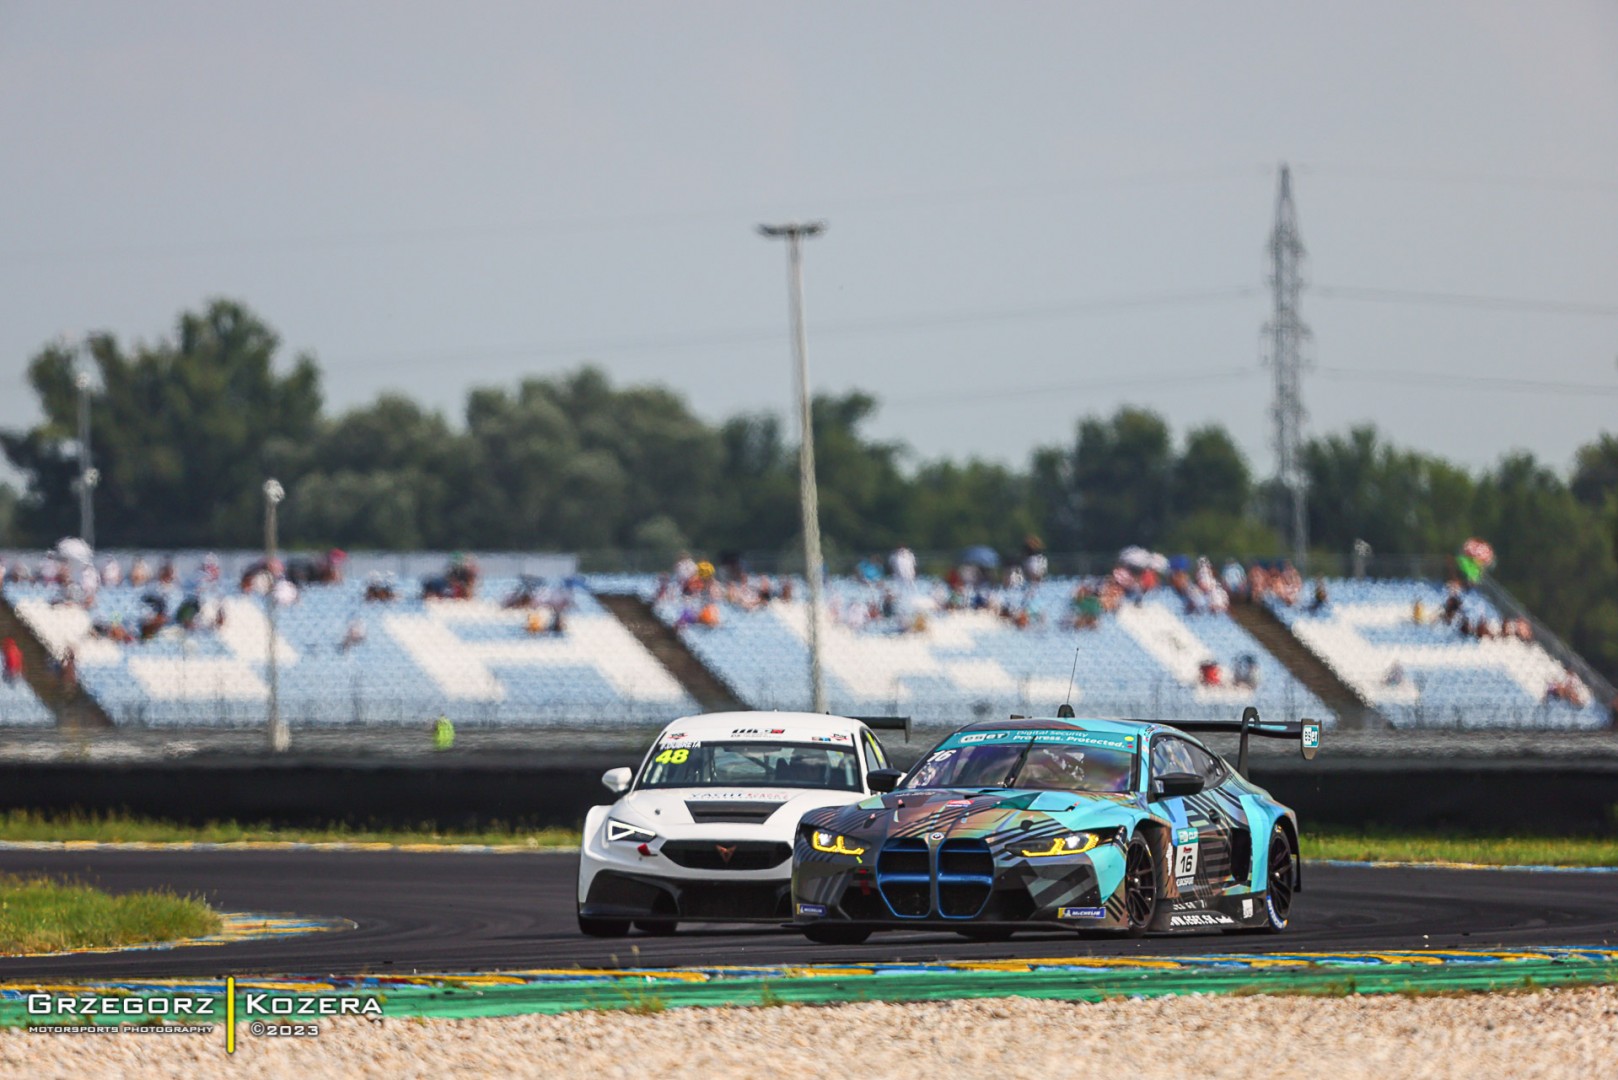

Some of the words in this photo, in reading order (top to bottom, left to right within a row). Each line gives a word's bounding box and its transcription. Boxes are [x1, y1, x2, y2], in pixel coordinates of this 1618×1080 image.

[1050, 730, 1088, 738] Security
[1066, 736, 1125, 749] Protected.
[655, 748, 689, 765] 48
[927, 749, 957, 763] 16
[1180, 854, 1193, 874] 16
